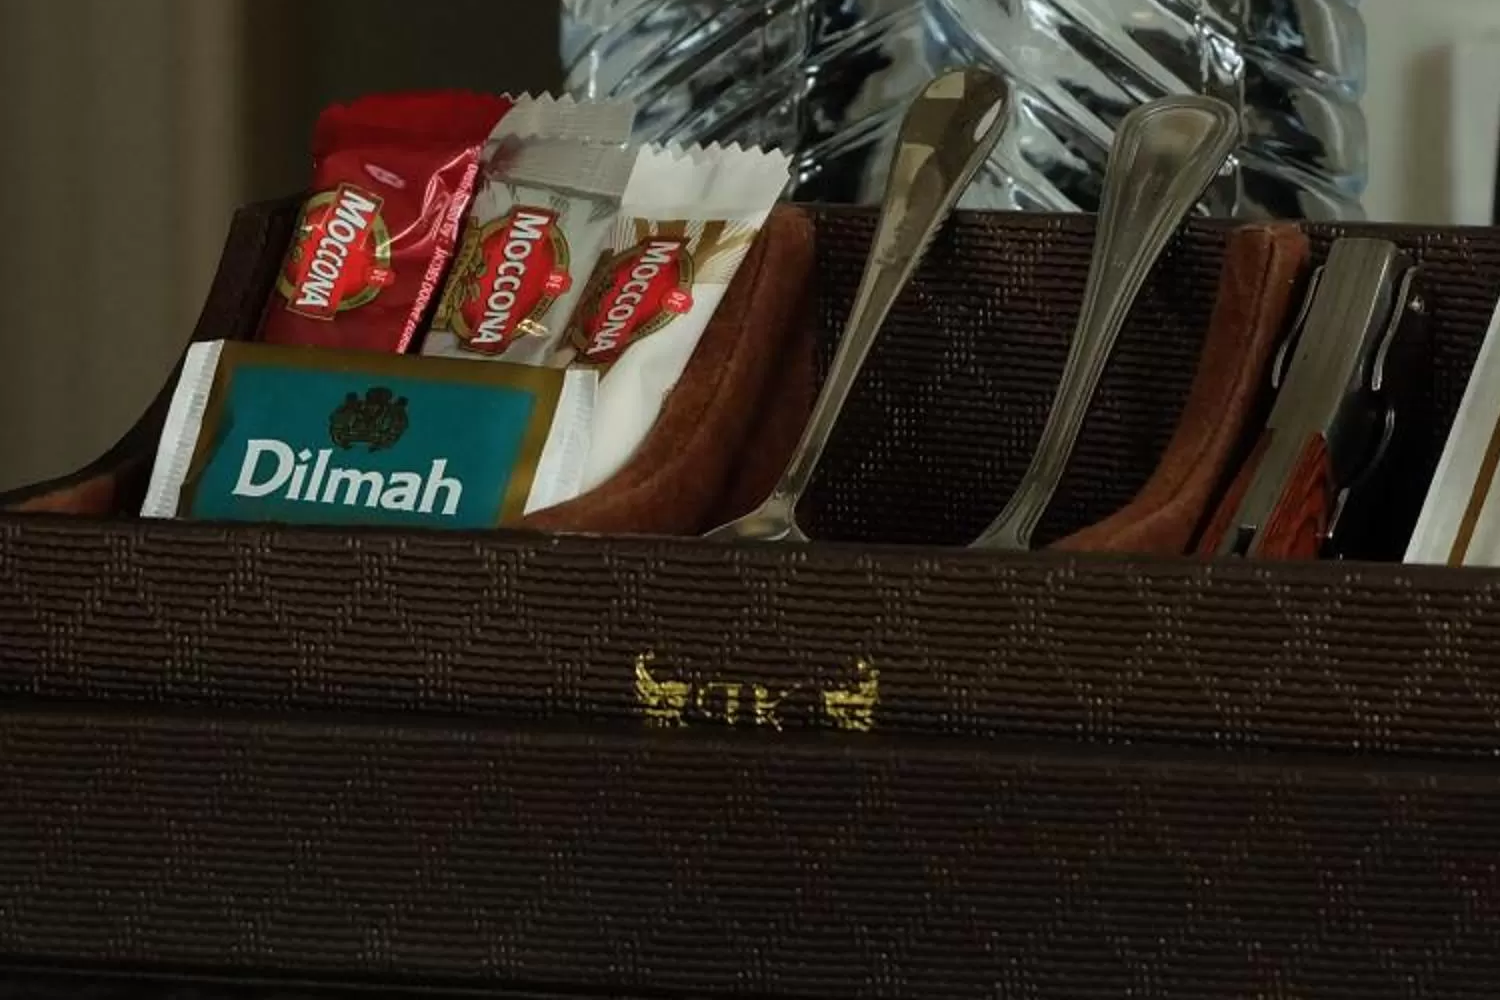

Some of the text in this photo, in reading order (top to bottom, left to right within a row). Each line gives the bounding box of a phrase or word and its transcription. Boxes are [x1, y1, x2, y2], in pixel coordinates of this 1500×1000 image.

[296, 190, 377, 307] MOCCONA
[471, 212, 550, 344] MOCCONA
[586, 241, 681, 355] MOCCONA
[231, 439, 463, 515] Dilmah
